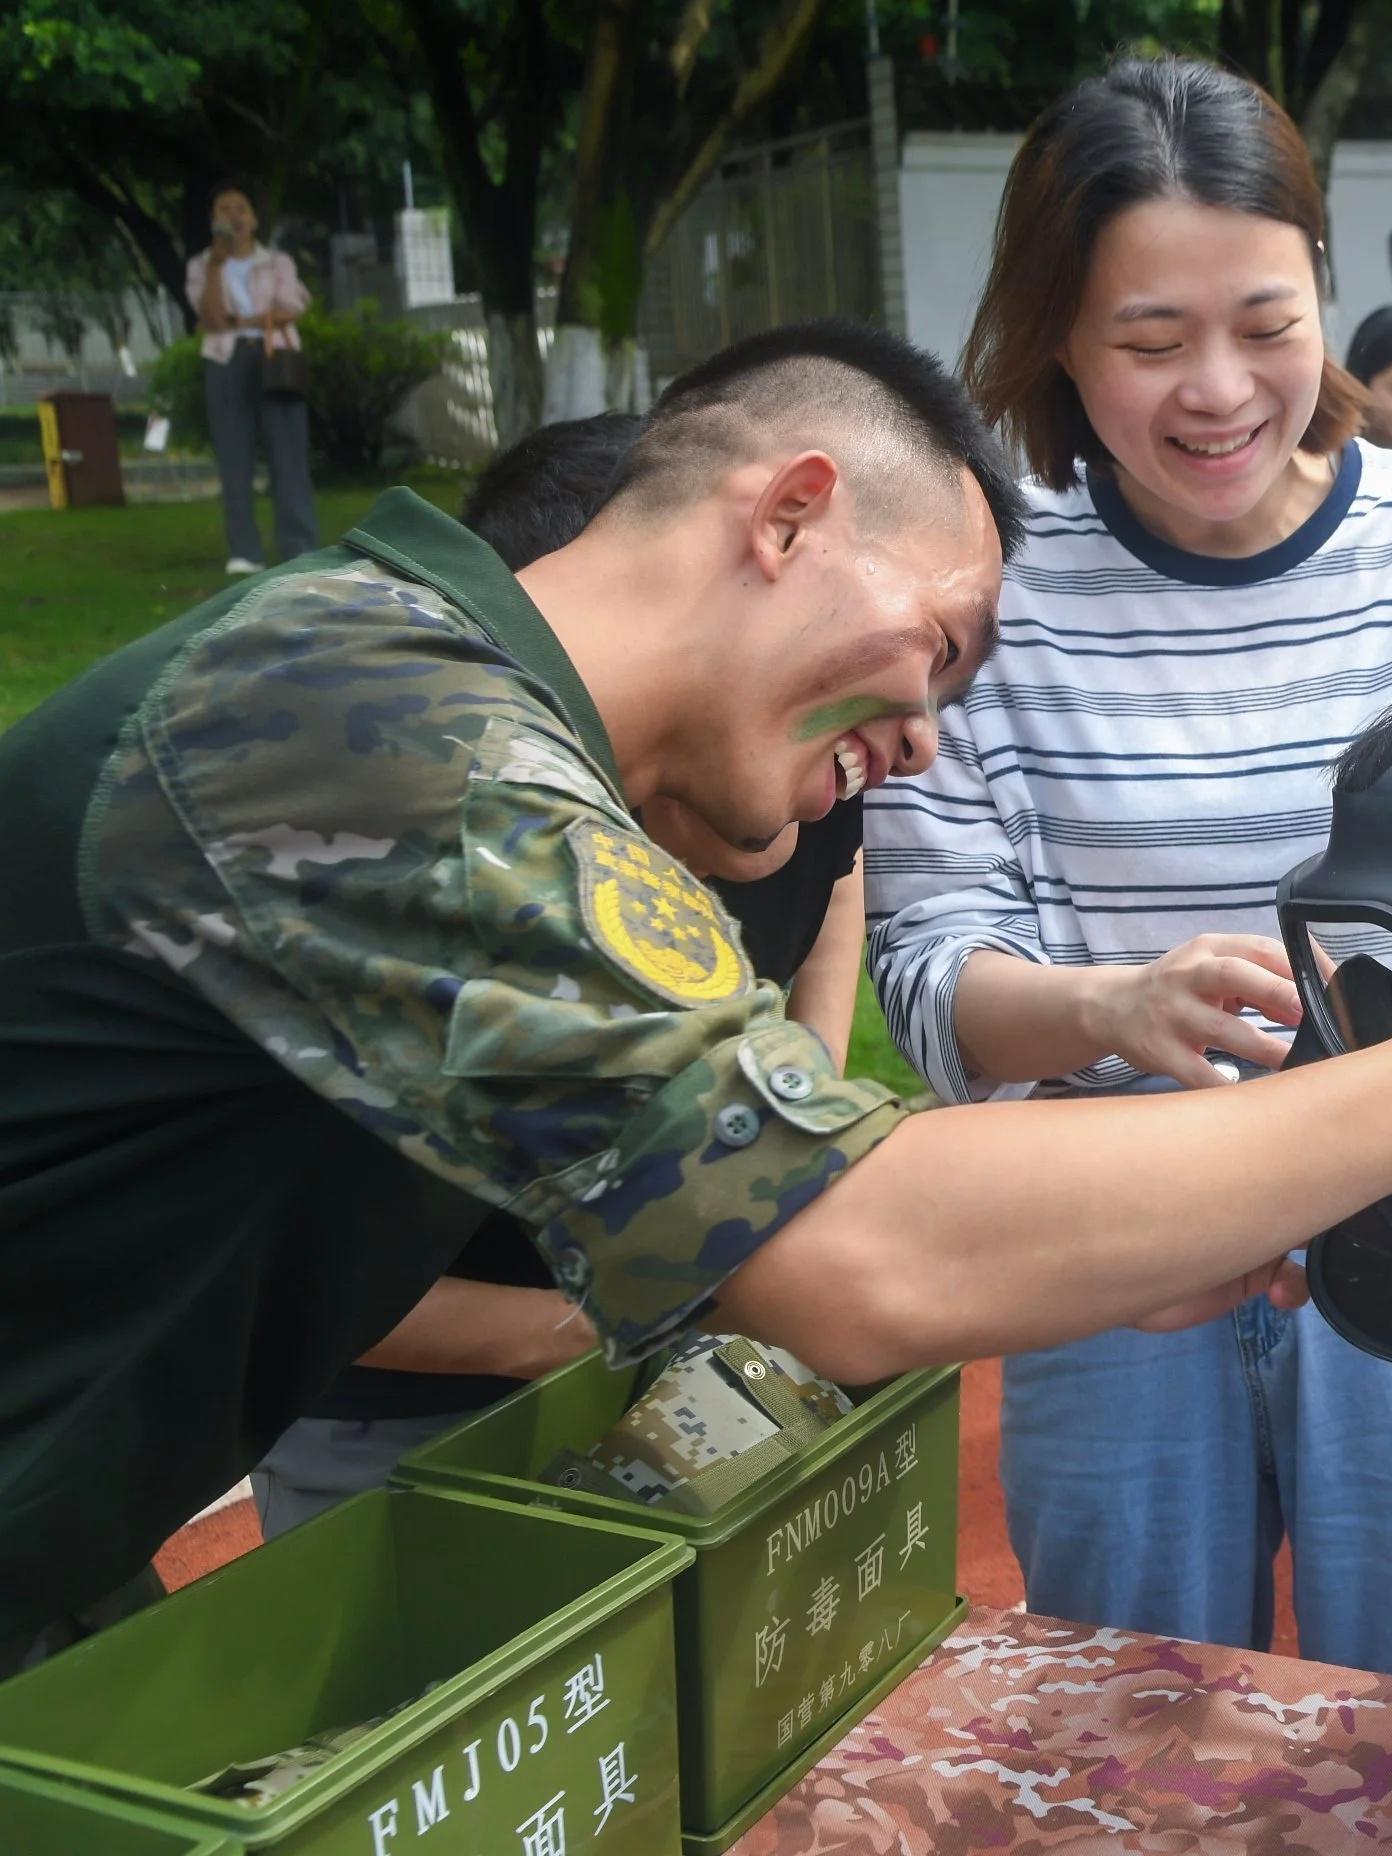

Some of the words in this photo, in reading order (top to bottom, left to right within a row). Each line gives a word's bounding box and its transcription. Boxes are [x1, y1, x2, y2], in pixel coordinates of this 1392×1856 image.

[766, 1423, 919, 1576] FNM009A型
[755, 1501, 930, 1688] 防毒面具
[367, 1653, 612, 1856] FMJ05型
[777, 1610, 911, 1750] 国营第九零八厂
[515, 1741, 639, 1856] 面具
